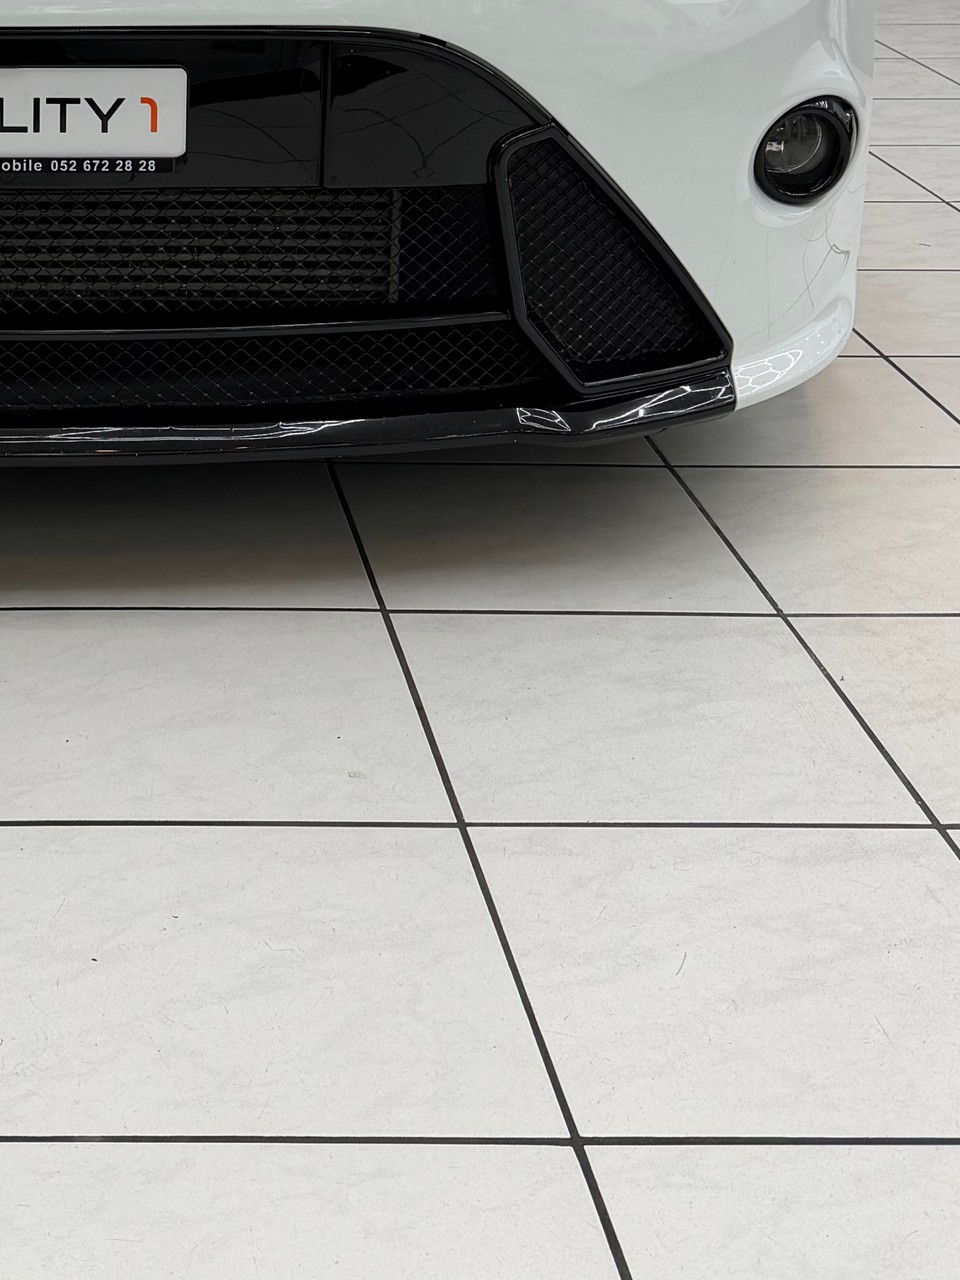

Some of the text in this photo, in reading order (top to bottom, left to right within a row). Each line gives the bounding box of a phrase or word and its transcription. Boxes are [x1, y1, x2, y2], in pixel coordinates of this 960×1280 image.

[139, 96, 158, 133] 1
[50, 159, 77, 173] 052
[83, 159, 110, 173] 672
[115, 159, 133, 173] 28
[138, 159, 156, 173] 28
